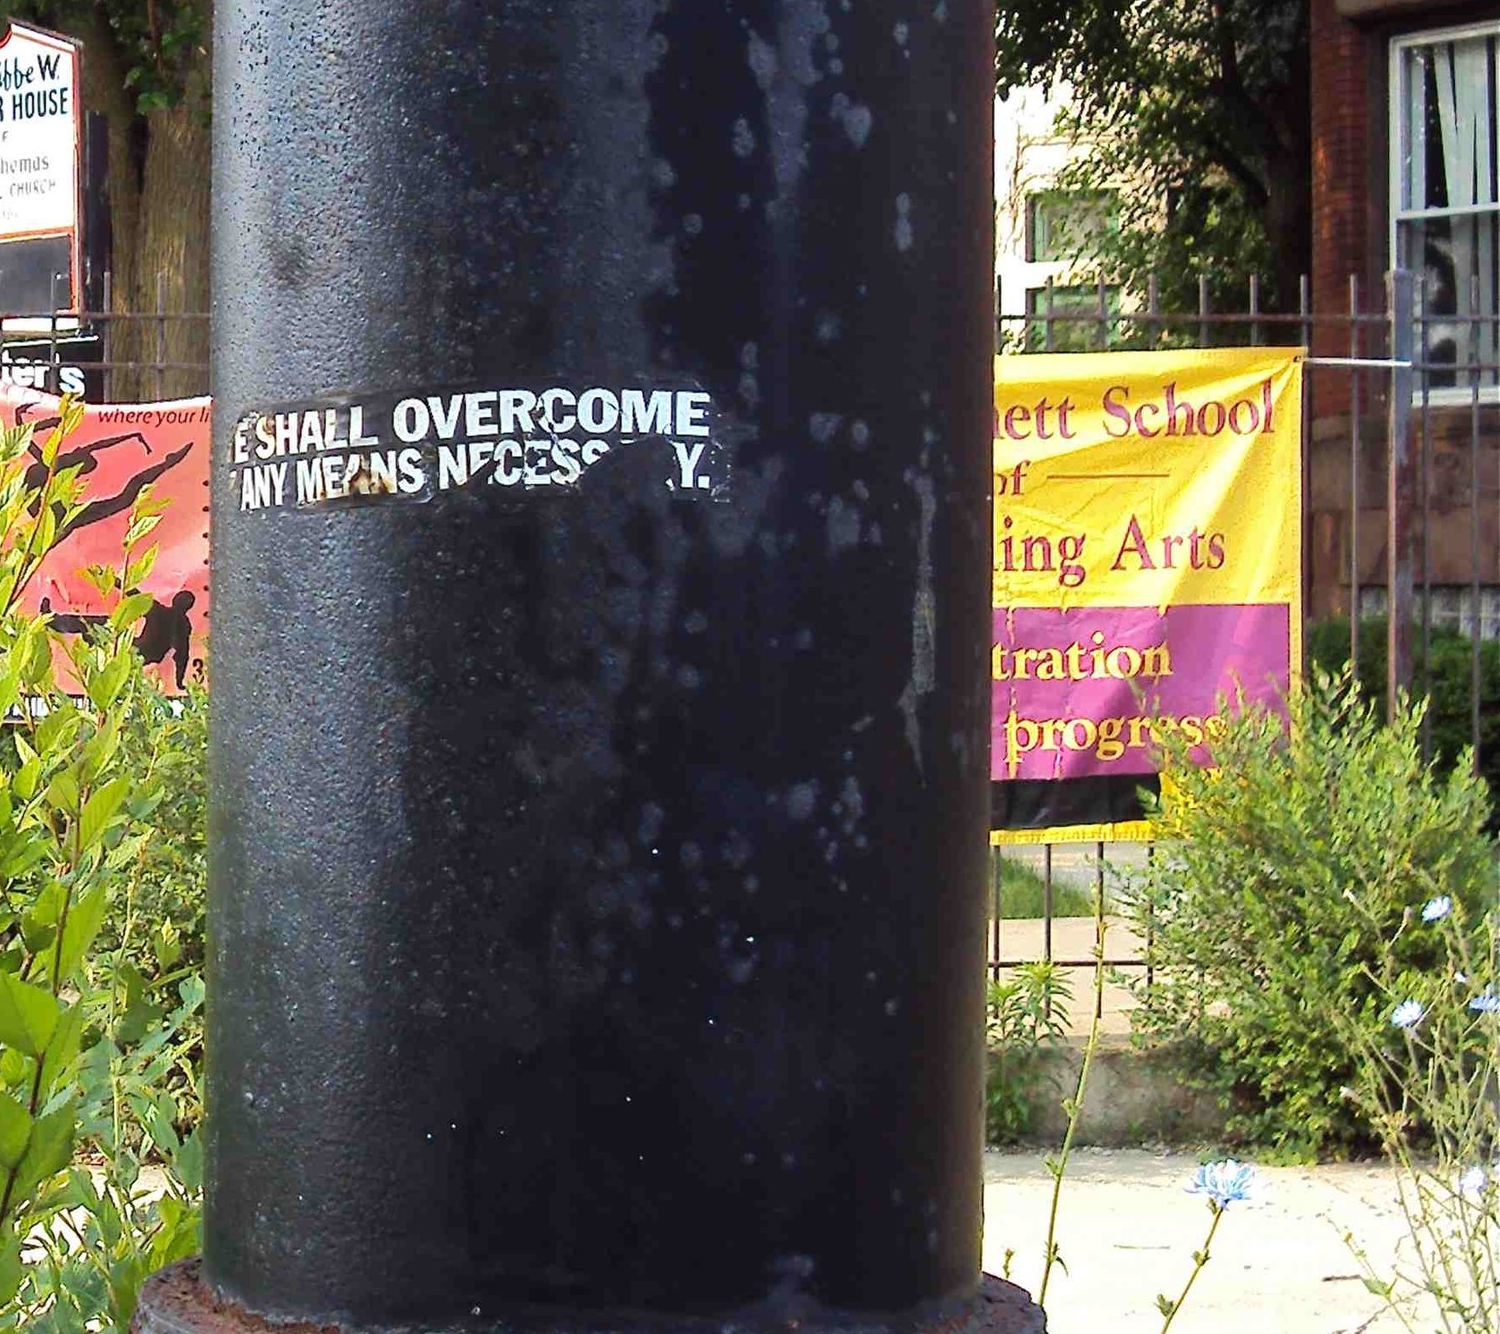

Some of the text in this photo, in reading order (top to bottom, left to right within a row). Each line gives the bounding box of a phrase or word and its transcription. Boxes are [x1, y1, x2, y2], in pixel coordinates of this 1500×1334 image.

[12, 87, 69, 121] HOUSE
[9, 178, 56, 198] CHURCH
[98, 408, 152, 424] where
[154, 411, 196, 429] your
[255, 405, 379, 460] SHALL
[392, 387, 711, 443] OVERCOME
[1102, 378, 1276, 438] School
[240, 461, 288, 512] ANY
[297, 447, 428, 504] MEANS
[993, 513, 1226, 589] ing Arts
